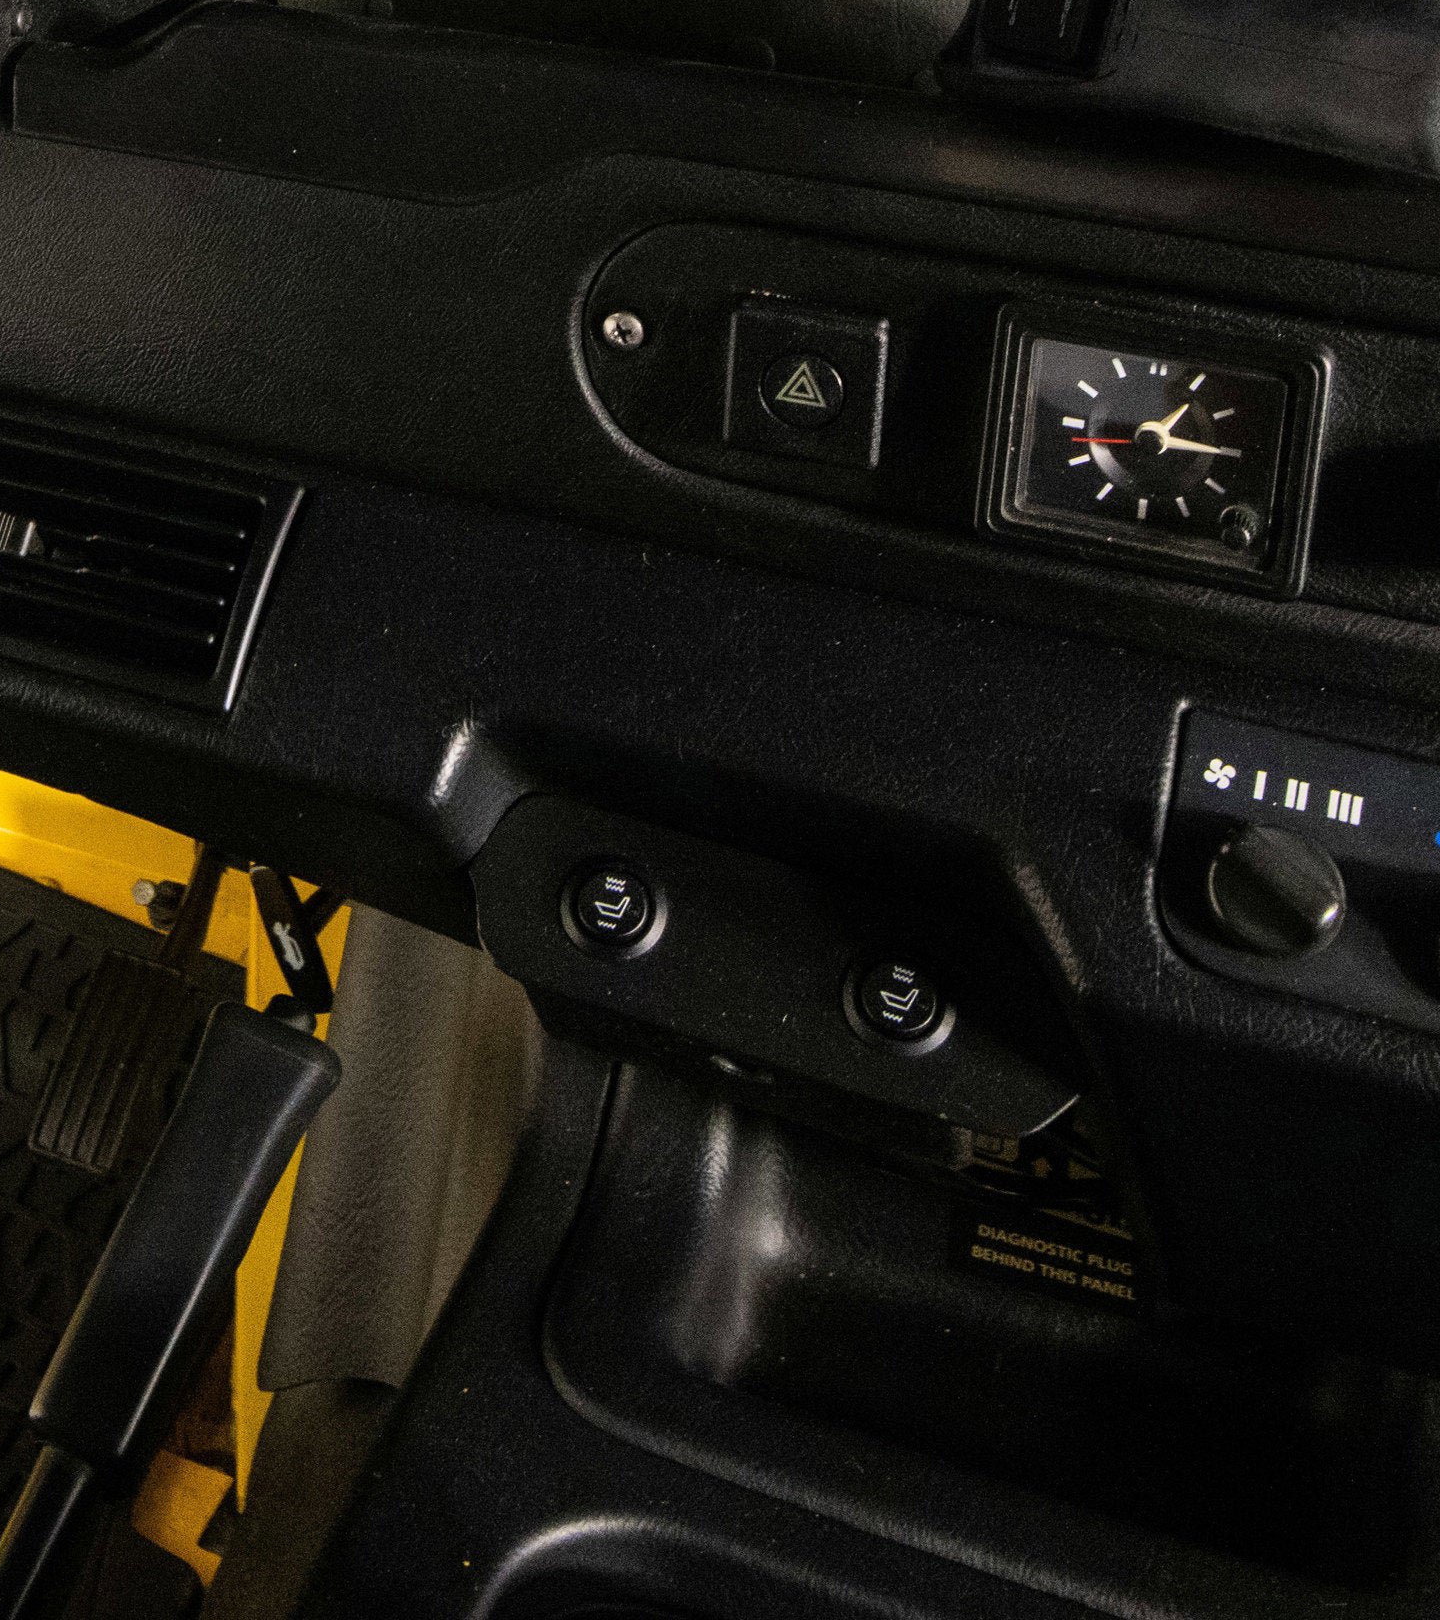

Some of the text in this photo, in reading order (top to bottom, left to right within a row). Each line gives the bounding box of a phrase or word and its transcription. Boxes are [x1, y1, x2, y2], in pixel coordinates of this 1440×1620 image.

[970, 1244, 1136, 1301] BEHIND THIS PANEL
[977, 1223, 1134, 1276] DIAGNOSTIC PLUG
